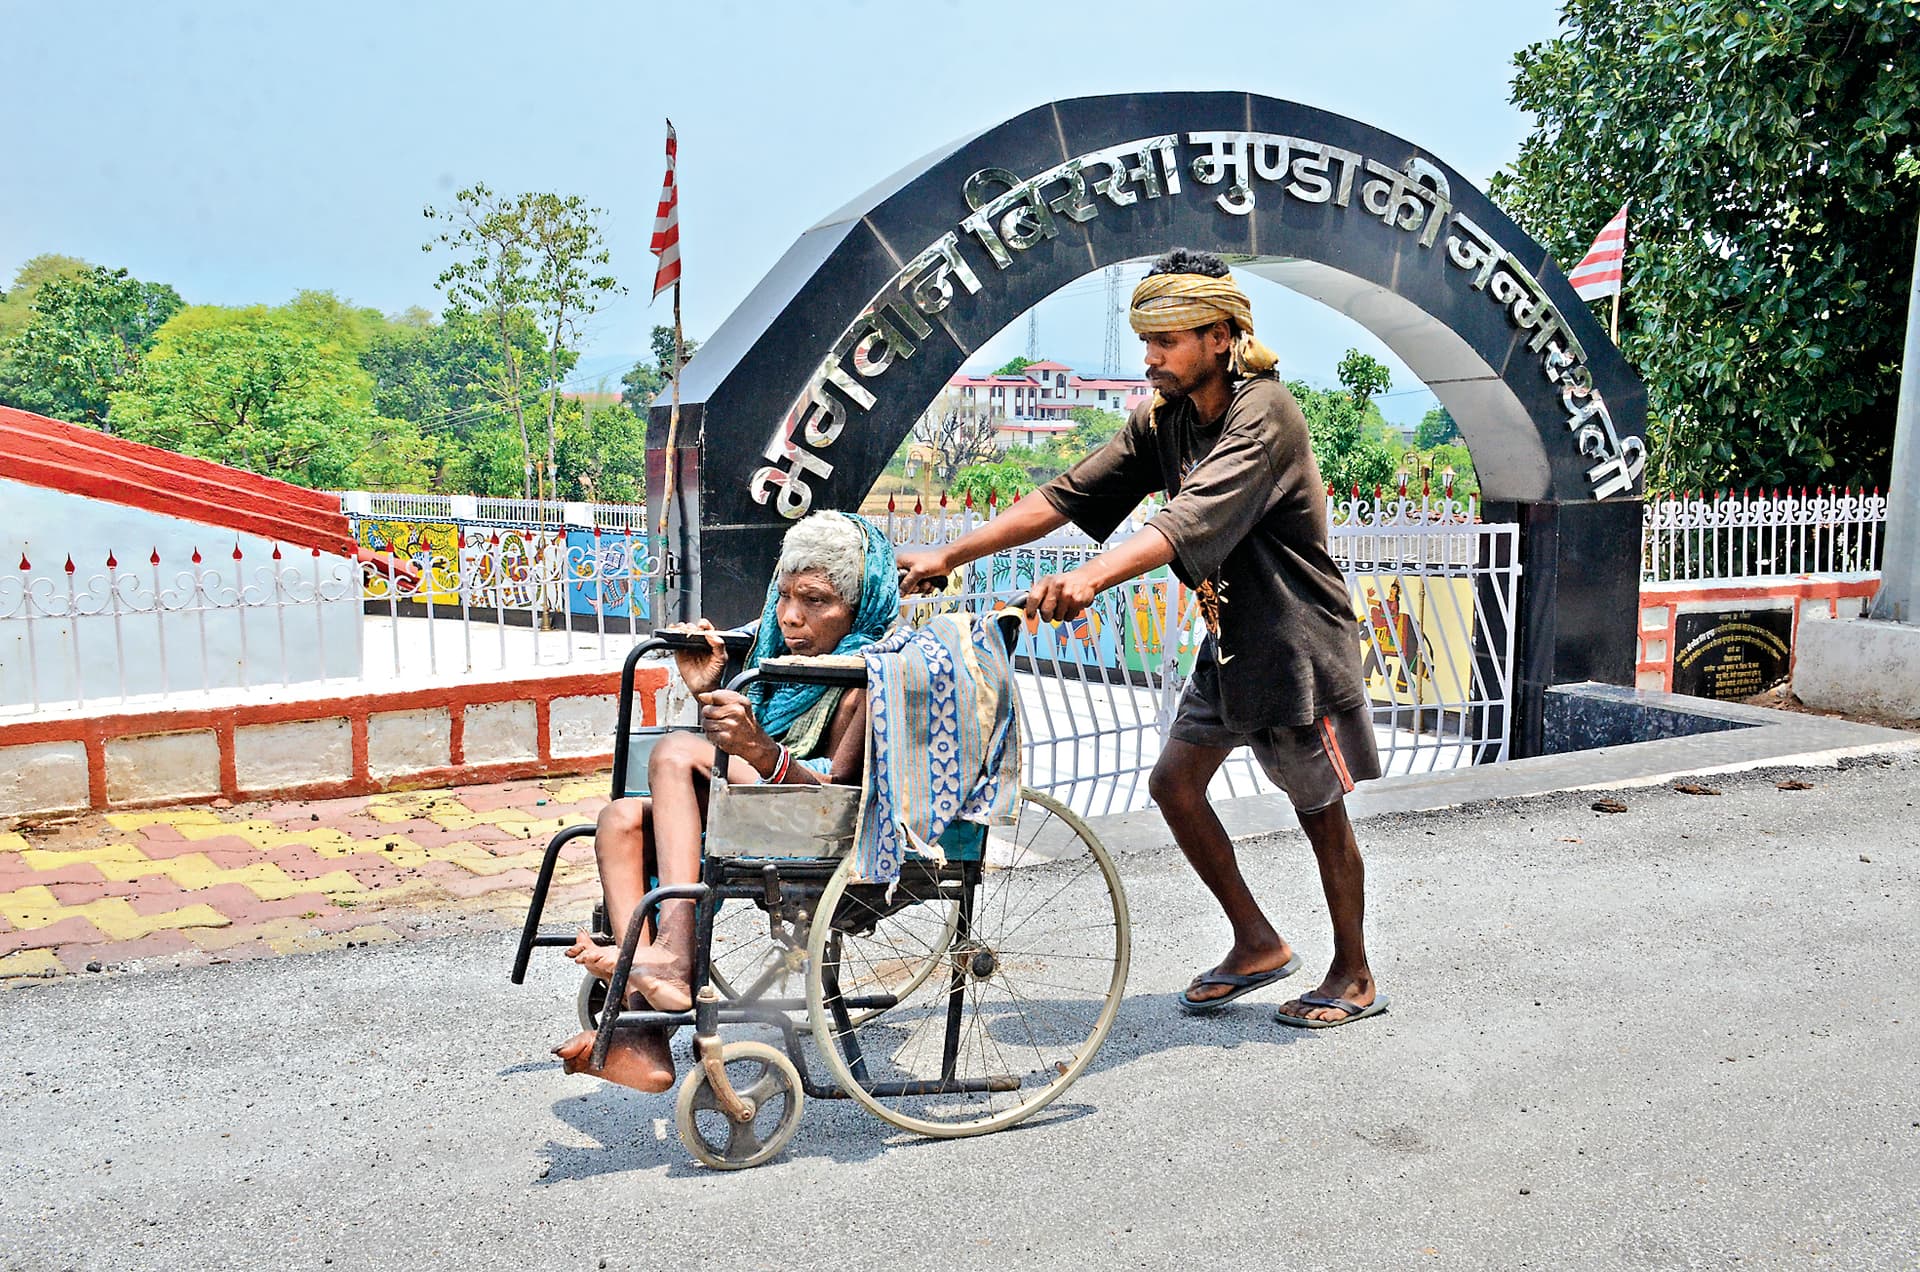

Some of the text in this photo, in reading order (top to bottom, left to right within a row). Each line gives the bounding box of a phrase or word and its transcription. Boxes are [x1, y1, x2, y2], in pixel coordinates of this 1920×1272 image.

[750, 231, 983, 520] भगवान
[959, 133, 1181, 270] बिरसा
[1189, 131, 1363, 216] मुण्डा
[1361, 156, 1453, 248] की
